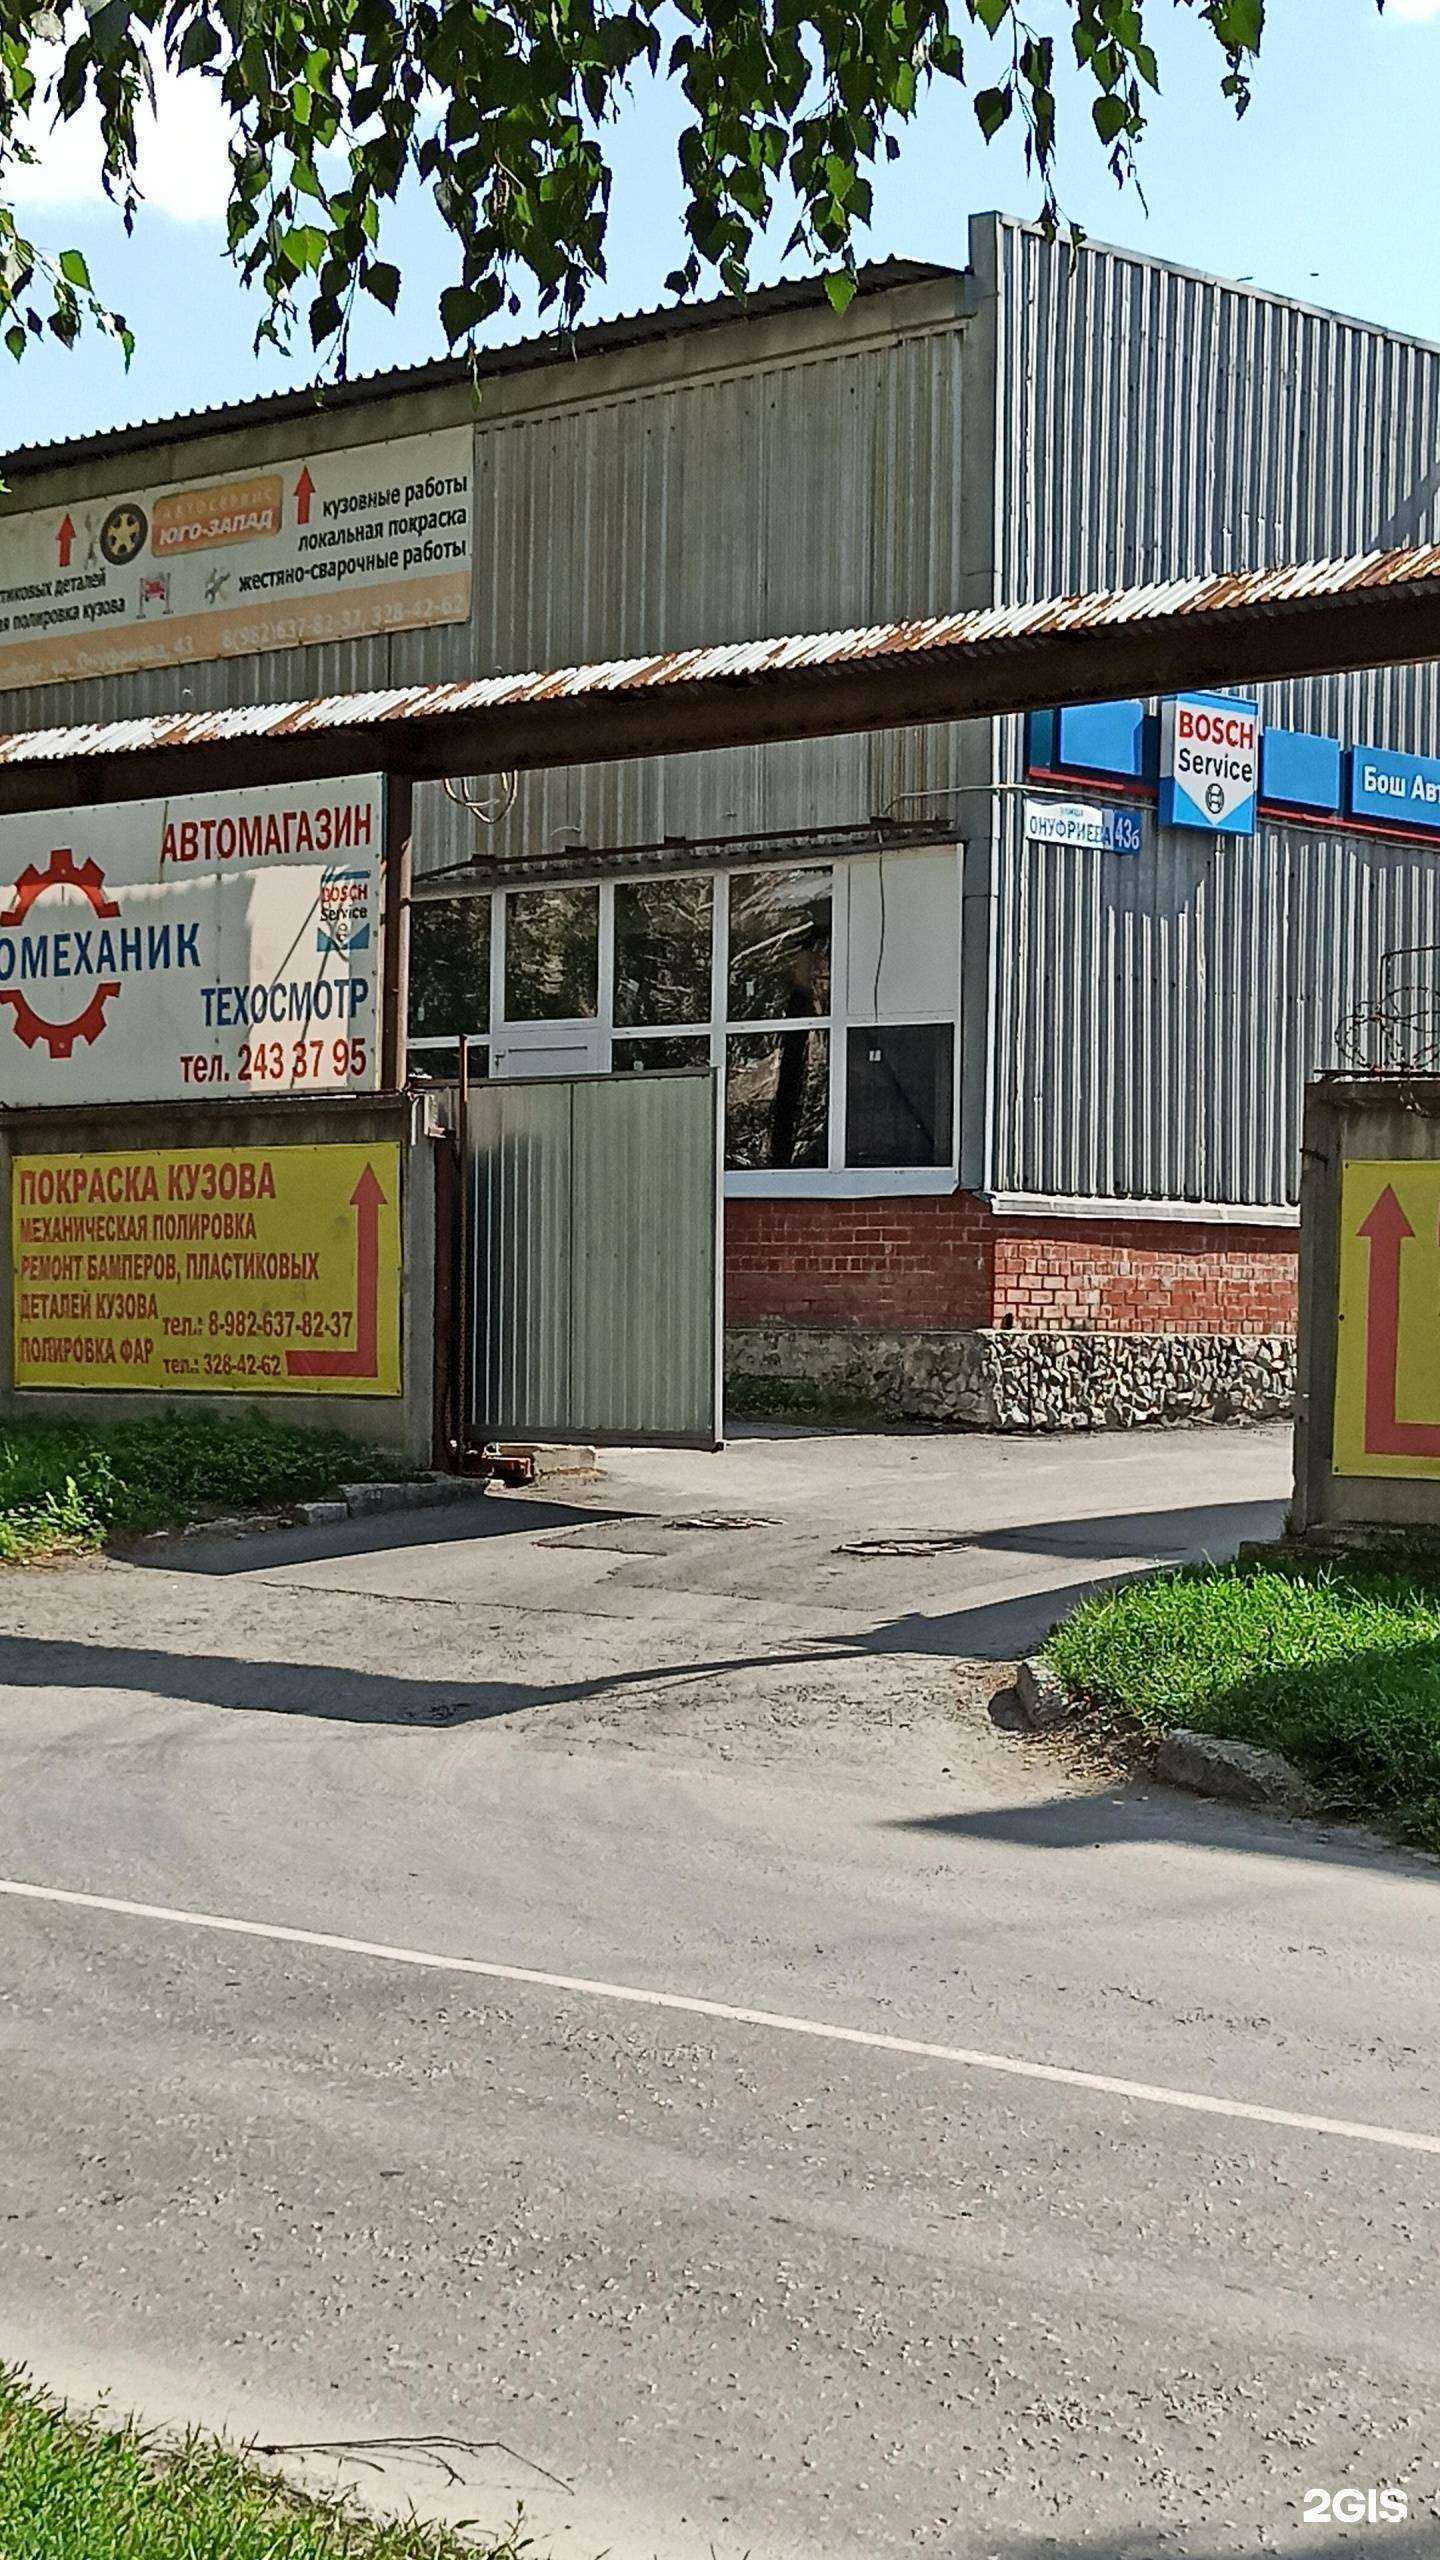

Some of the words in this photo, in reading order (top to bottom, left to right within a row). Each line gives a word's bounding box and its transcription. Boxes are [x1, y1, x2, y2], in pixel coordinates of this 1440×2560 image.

[322, 488, 400, 519] кузовные
[405, 476, 468, 507] работы
[160, 507, 273, 545] ЮГО-ЗАПАД
[299, 522, 383, 551] локальная
[388, 508, 467, 538] покраска
[54, 567, 106, 597] деталей
[239, 550, 399, 592] жестяно-сварочные
[403, 539, 467, 570] работы
[83, 598, 126, 622] кузова
[1178, 709, 1254, 749] BOSCH
[1178, 747, 1254, 783] Service
[1364, 765, 1406, 798] Бош
[161, 803, 372, 862] АВТОМАГАЗИН
[1029, 815, 1112, 847] ОНУФРИЕВА
[320, 883, 368, 902] BOSCH
[320, 906, 368, 921] Service
[0, 922, 200, 981] ОМЕХАНИК
[201, 977, 369, 1027] ТЕХОСМОТР
[180, 1054, 229, 1083] тел.
[237, 1041, 285, 1081] 243
[292, 1040, 323, 1078] 37
[333, 1037, 367, 1077] 95
[20, 1166, 160, 1205] ПОКРАСКА
[168, 1161, 276, 1201] КУЗОВА
[20, 1214, 147, 1243] МЕХАНИЧЕСКАЯ
[153, 1212, 256, 1241] ПОЛИРОВКА
[20, 1254, 83, 1281] РЕМОНТ
[87, 1252, 181, 1284] БАМПЕРОВ,
[186, 1252, 320, 1280] ПЛАСТИКОВЫХ
[20, 1290, 91, 1322] ДЕТАЛЕЙ
[96, 1293, 159, 1320] КУЗОВА
[208, 1310, 353, 1338] 8-982-637-82-37
[20, 1336, 117, 1364] ПОЛИРОВКА
[120, 1336, 154, 1364] ФАР
